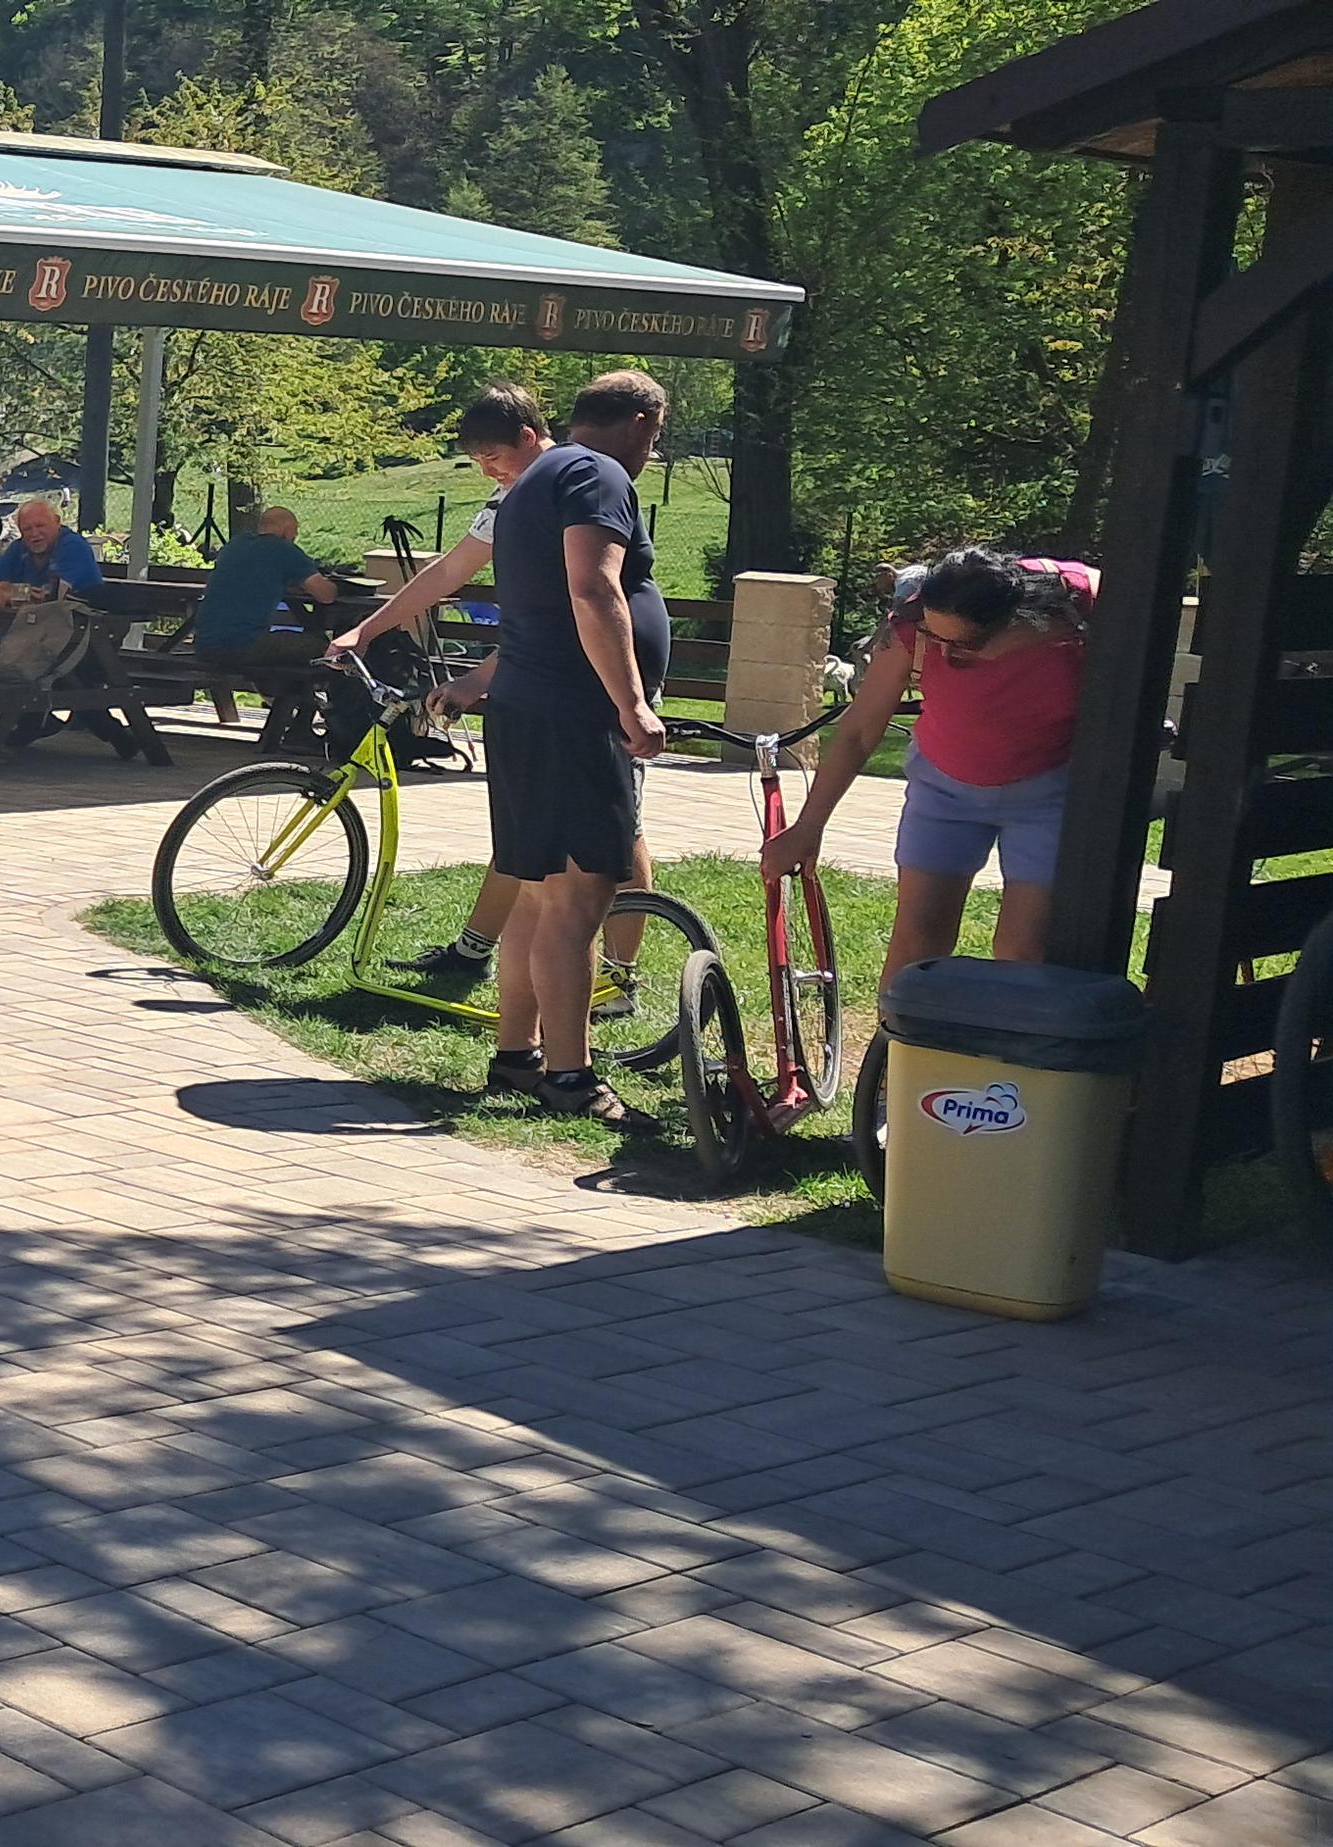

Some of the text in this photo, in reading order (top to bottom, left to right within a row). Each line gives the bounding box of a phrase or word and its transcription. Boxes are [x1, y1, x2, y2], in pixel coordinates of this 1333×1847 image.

[35, 265, 60, 299] R
[82, 274, 135, 301] PIVO
[138, 272, 241, 307] ČESKÉHO
[244, 282, 293, 315] RÁJE
[309, 282, 331, 314] R
[348, 291, 393, 318] PIVO
[397, 291, 484, 324] ČESKÉHO
[574, 308, 615, 330] PIVO
[943, 1098, 1010, 1125] Prima
